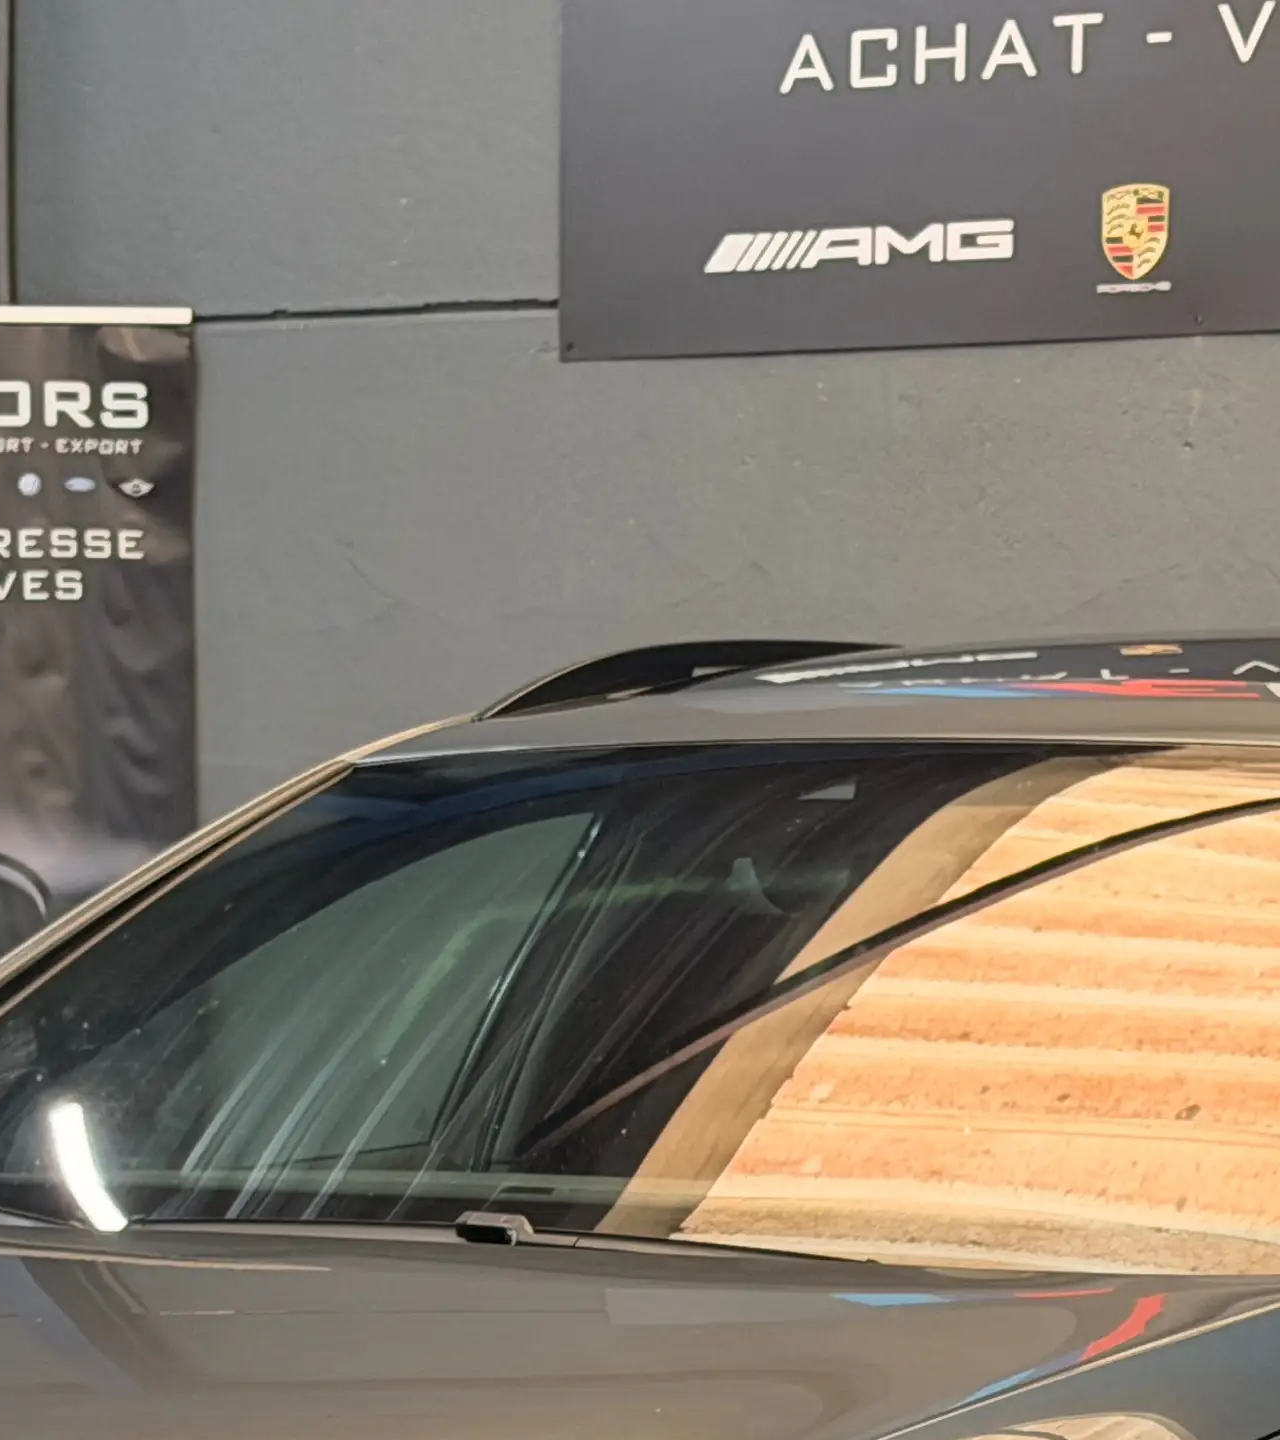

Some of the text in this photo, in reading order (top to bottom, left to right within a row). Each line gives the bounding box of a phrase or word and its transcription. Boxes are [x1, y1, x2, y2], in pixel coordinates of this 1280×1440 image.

[780, 12, 1104, 94] ACHAT
[814, 219, 1014, 267] AMG
[55, 437, 144, 455] EXPORT
